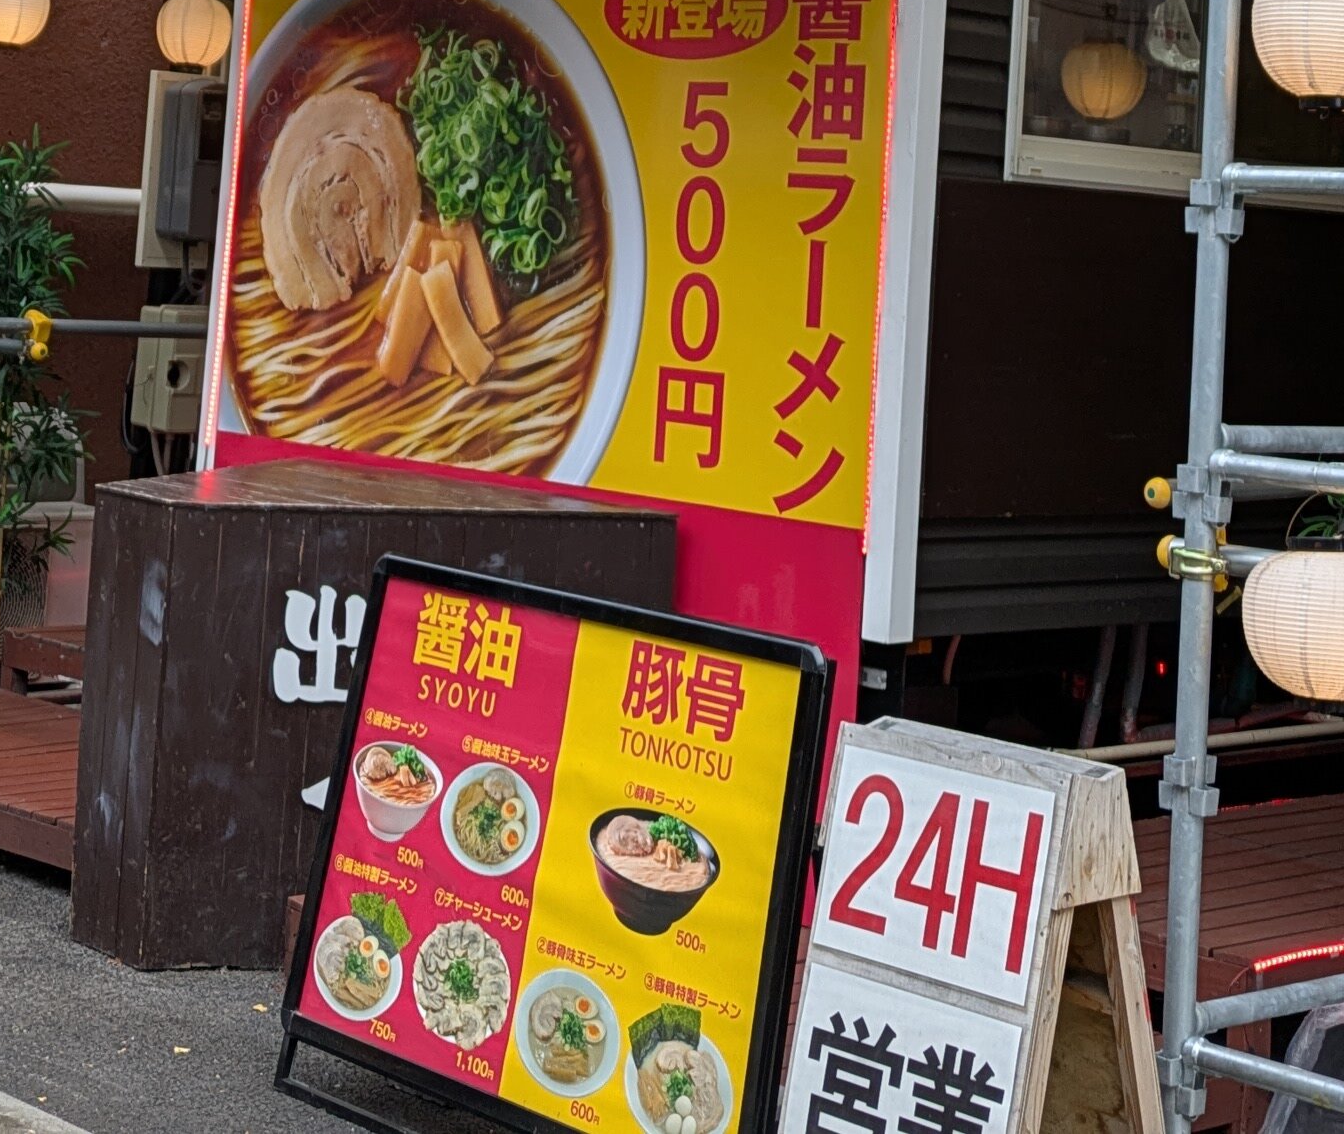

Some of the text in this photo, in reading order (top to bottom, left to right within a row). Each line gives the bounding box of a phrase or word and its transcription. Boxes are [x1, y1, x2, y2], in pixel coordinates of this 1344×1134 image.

[653, 81, 730, 469] 500円
[412, 591, 523, 689] 醤油
[417, 674, 497, 717] SYOYU
[621, 639, 746, 743] 豚骨
[619, 727, 734, 782] TONKOTSU
[396, 846, 424, 869] 500円
[828, 774, 1045, 975] 24H
[500, 884, 530, 909] 600円
[675, 929, 706, 953] 500円
[368, 1018, 397, 1042] 750円
[456, 1051, 495, 1080] 1,100円
[569, 1099, 600, 1126] 600円
